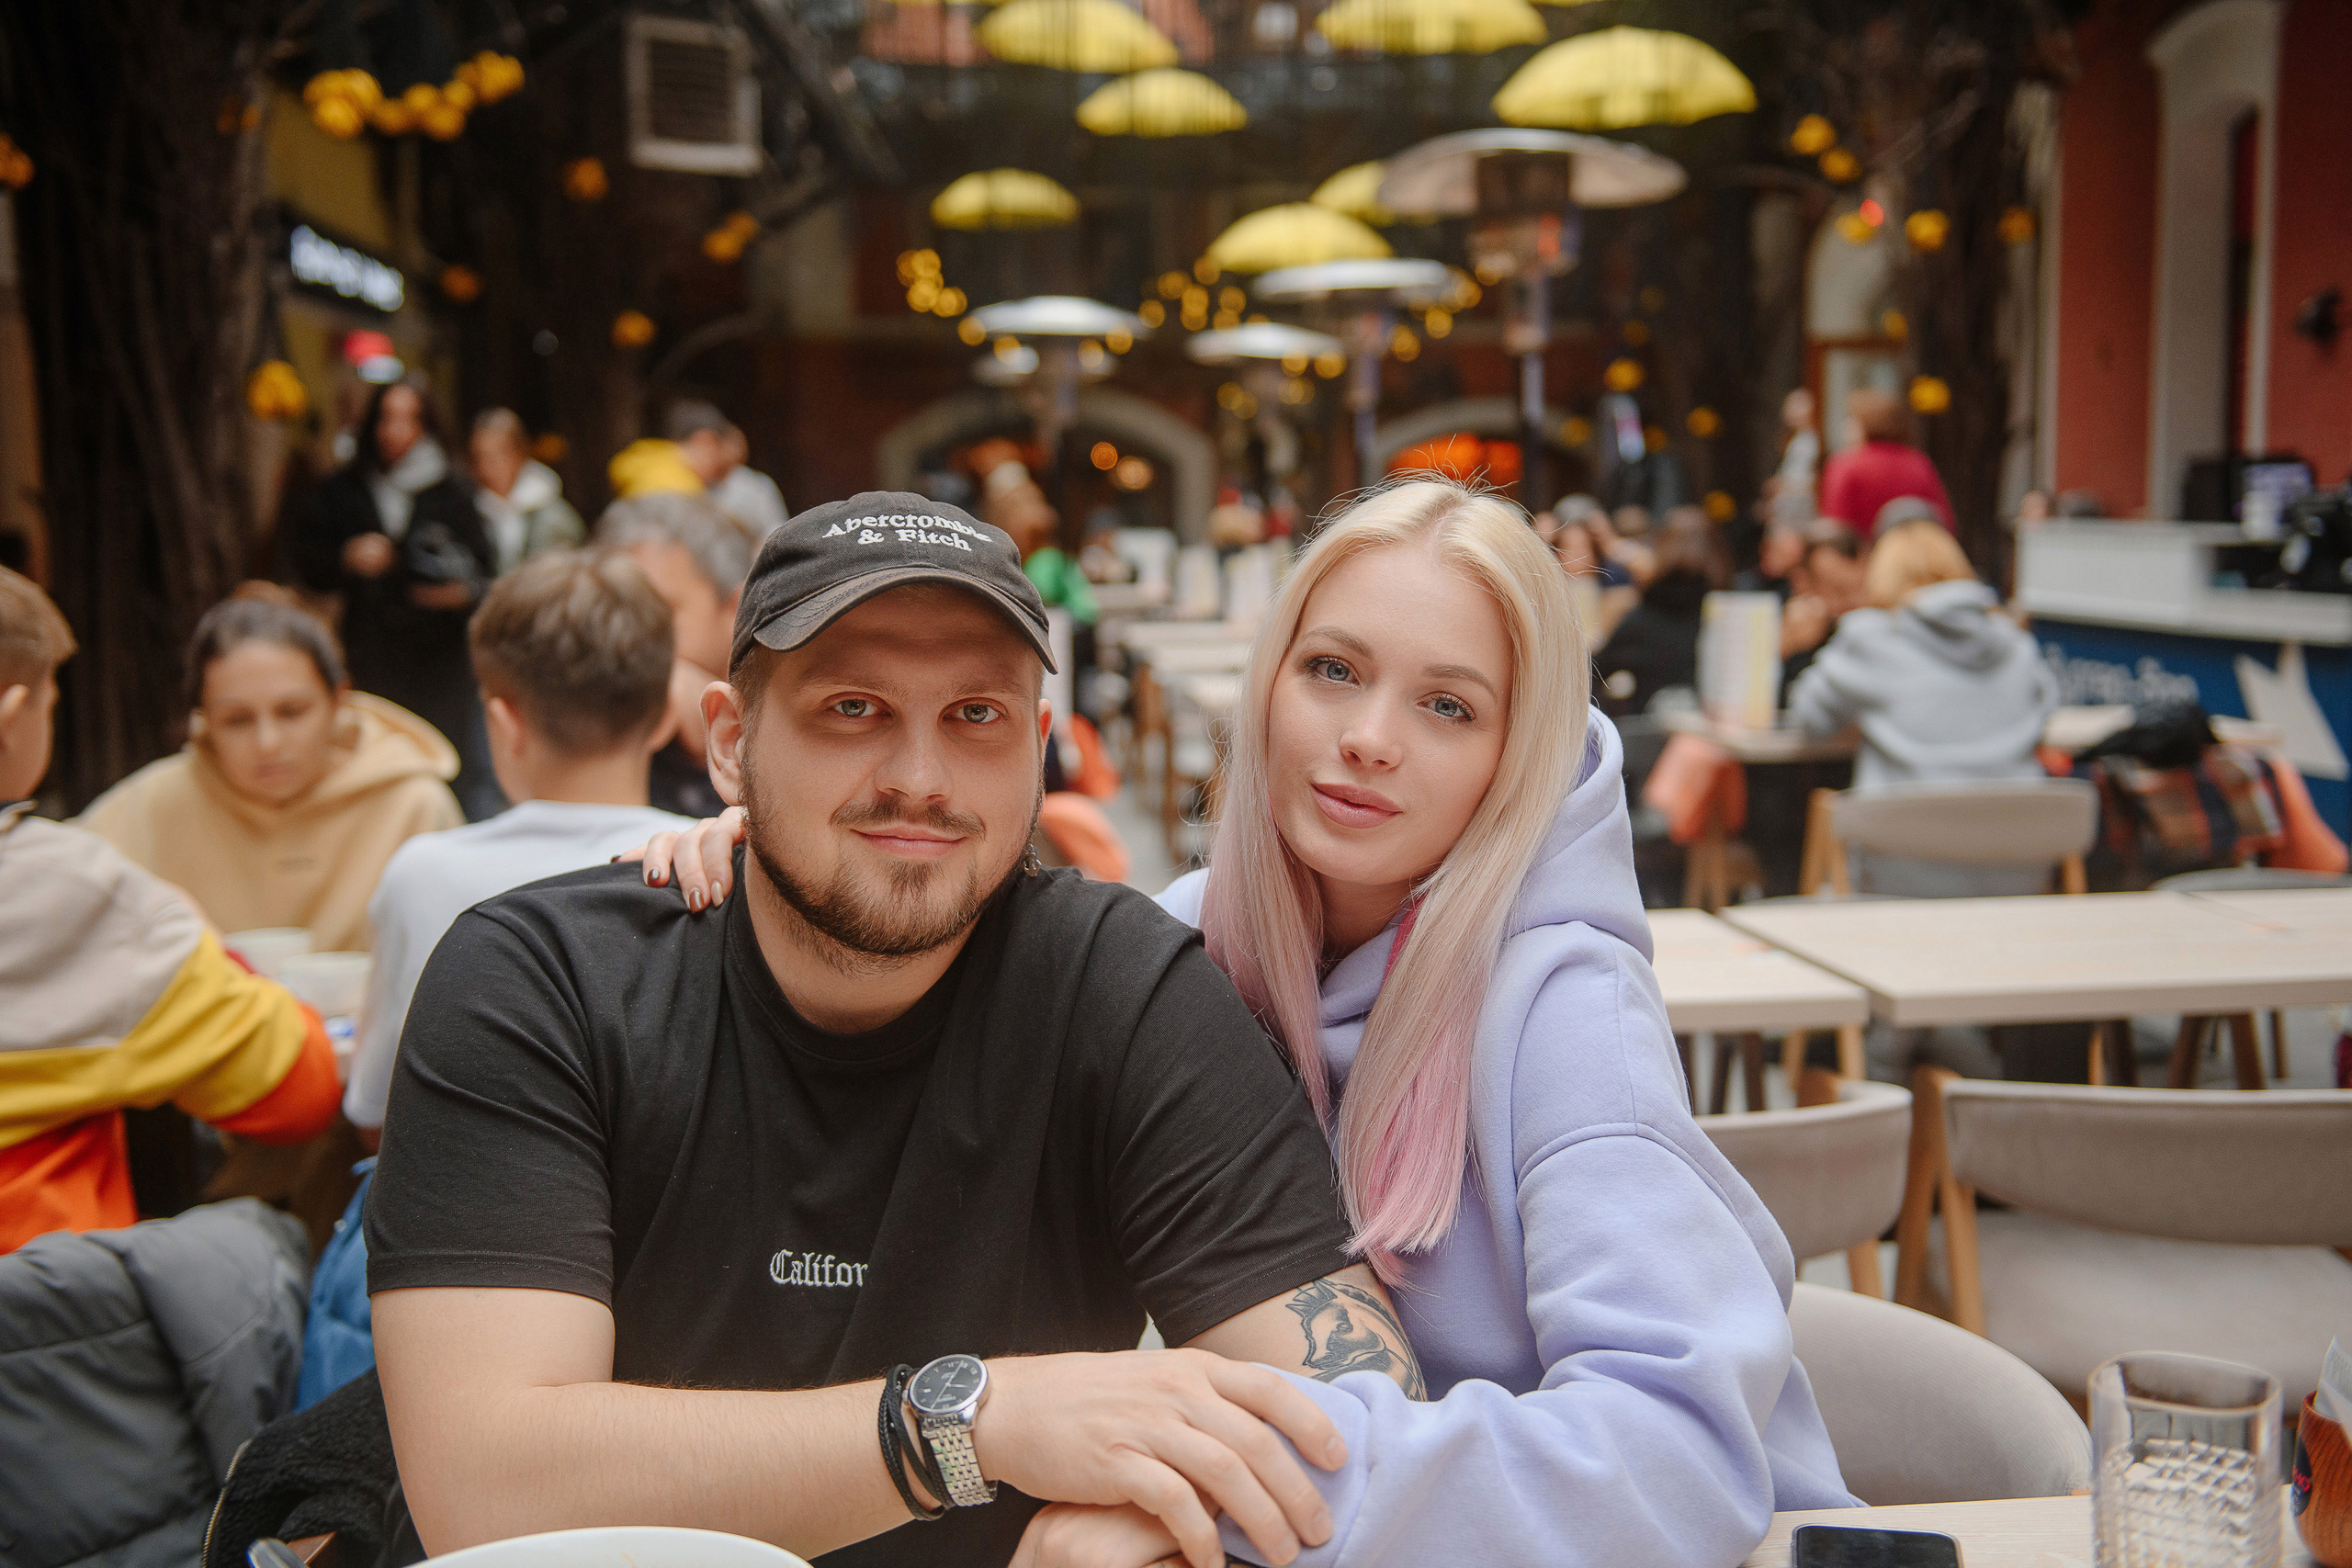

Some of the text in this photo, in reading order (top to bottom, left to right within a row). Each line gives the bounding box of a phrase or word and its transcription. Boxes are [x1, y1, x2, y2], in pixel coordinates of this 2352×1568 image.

[822, 514, 993, 542] Abercrombie
[857, 529, 972, 551] & Fitch
